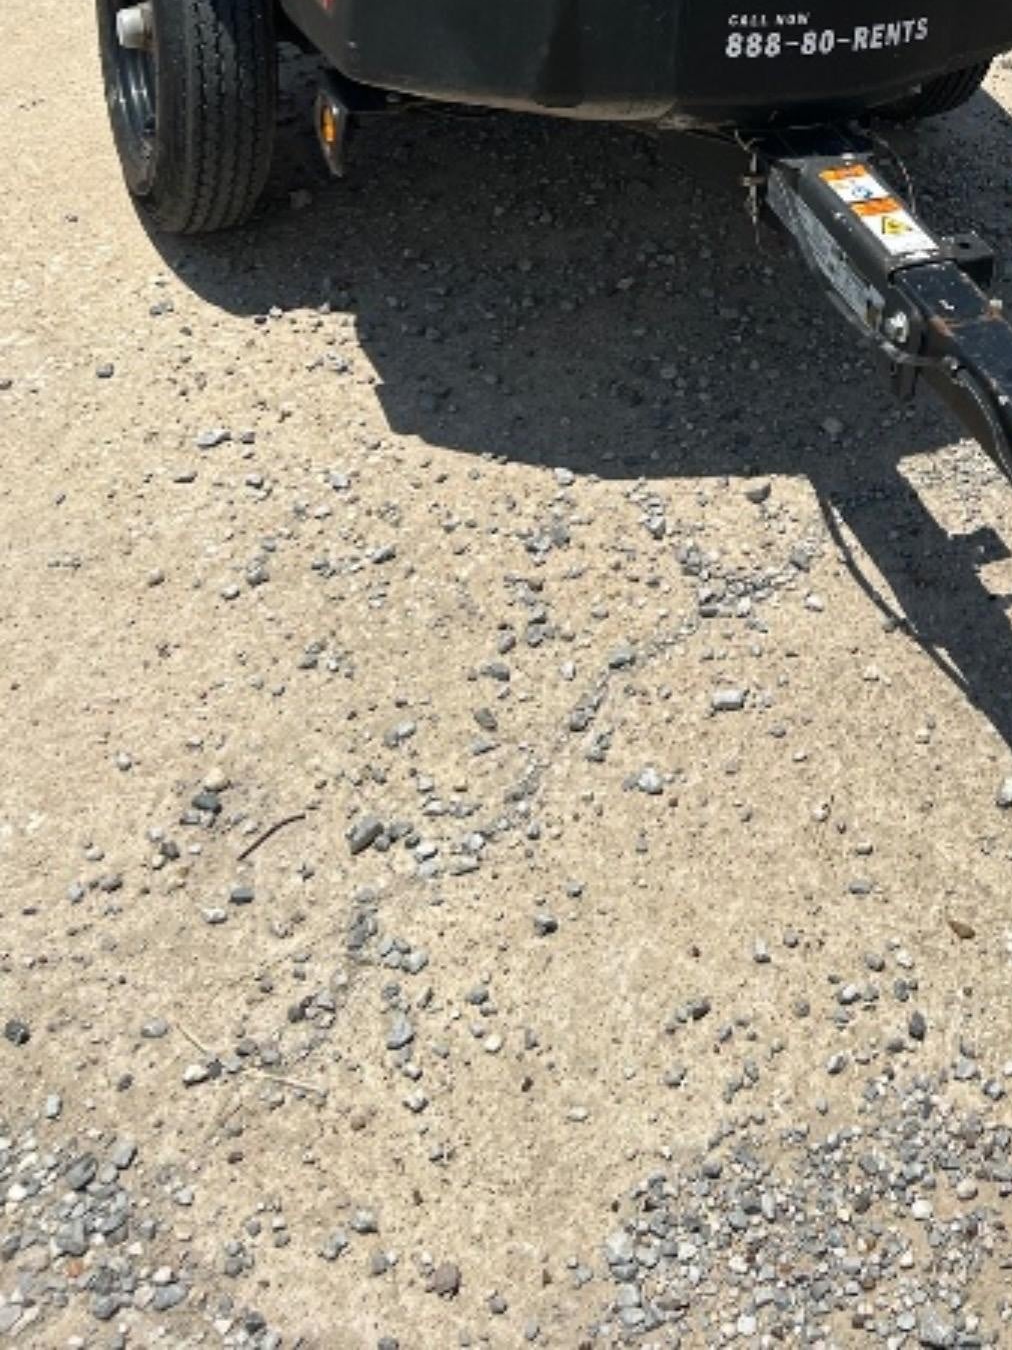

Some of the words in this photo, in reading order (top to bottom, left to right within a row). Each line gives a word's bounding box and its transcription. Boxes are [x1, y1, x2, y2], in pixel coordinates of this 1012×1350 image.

[728, 13, 768, 27] CALL
[776, 11, 811, 26] NOW
[725, 17, 929, 58] 888-80-RENTS
